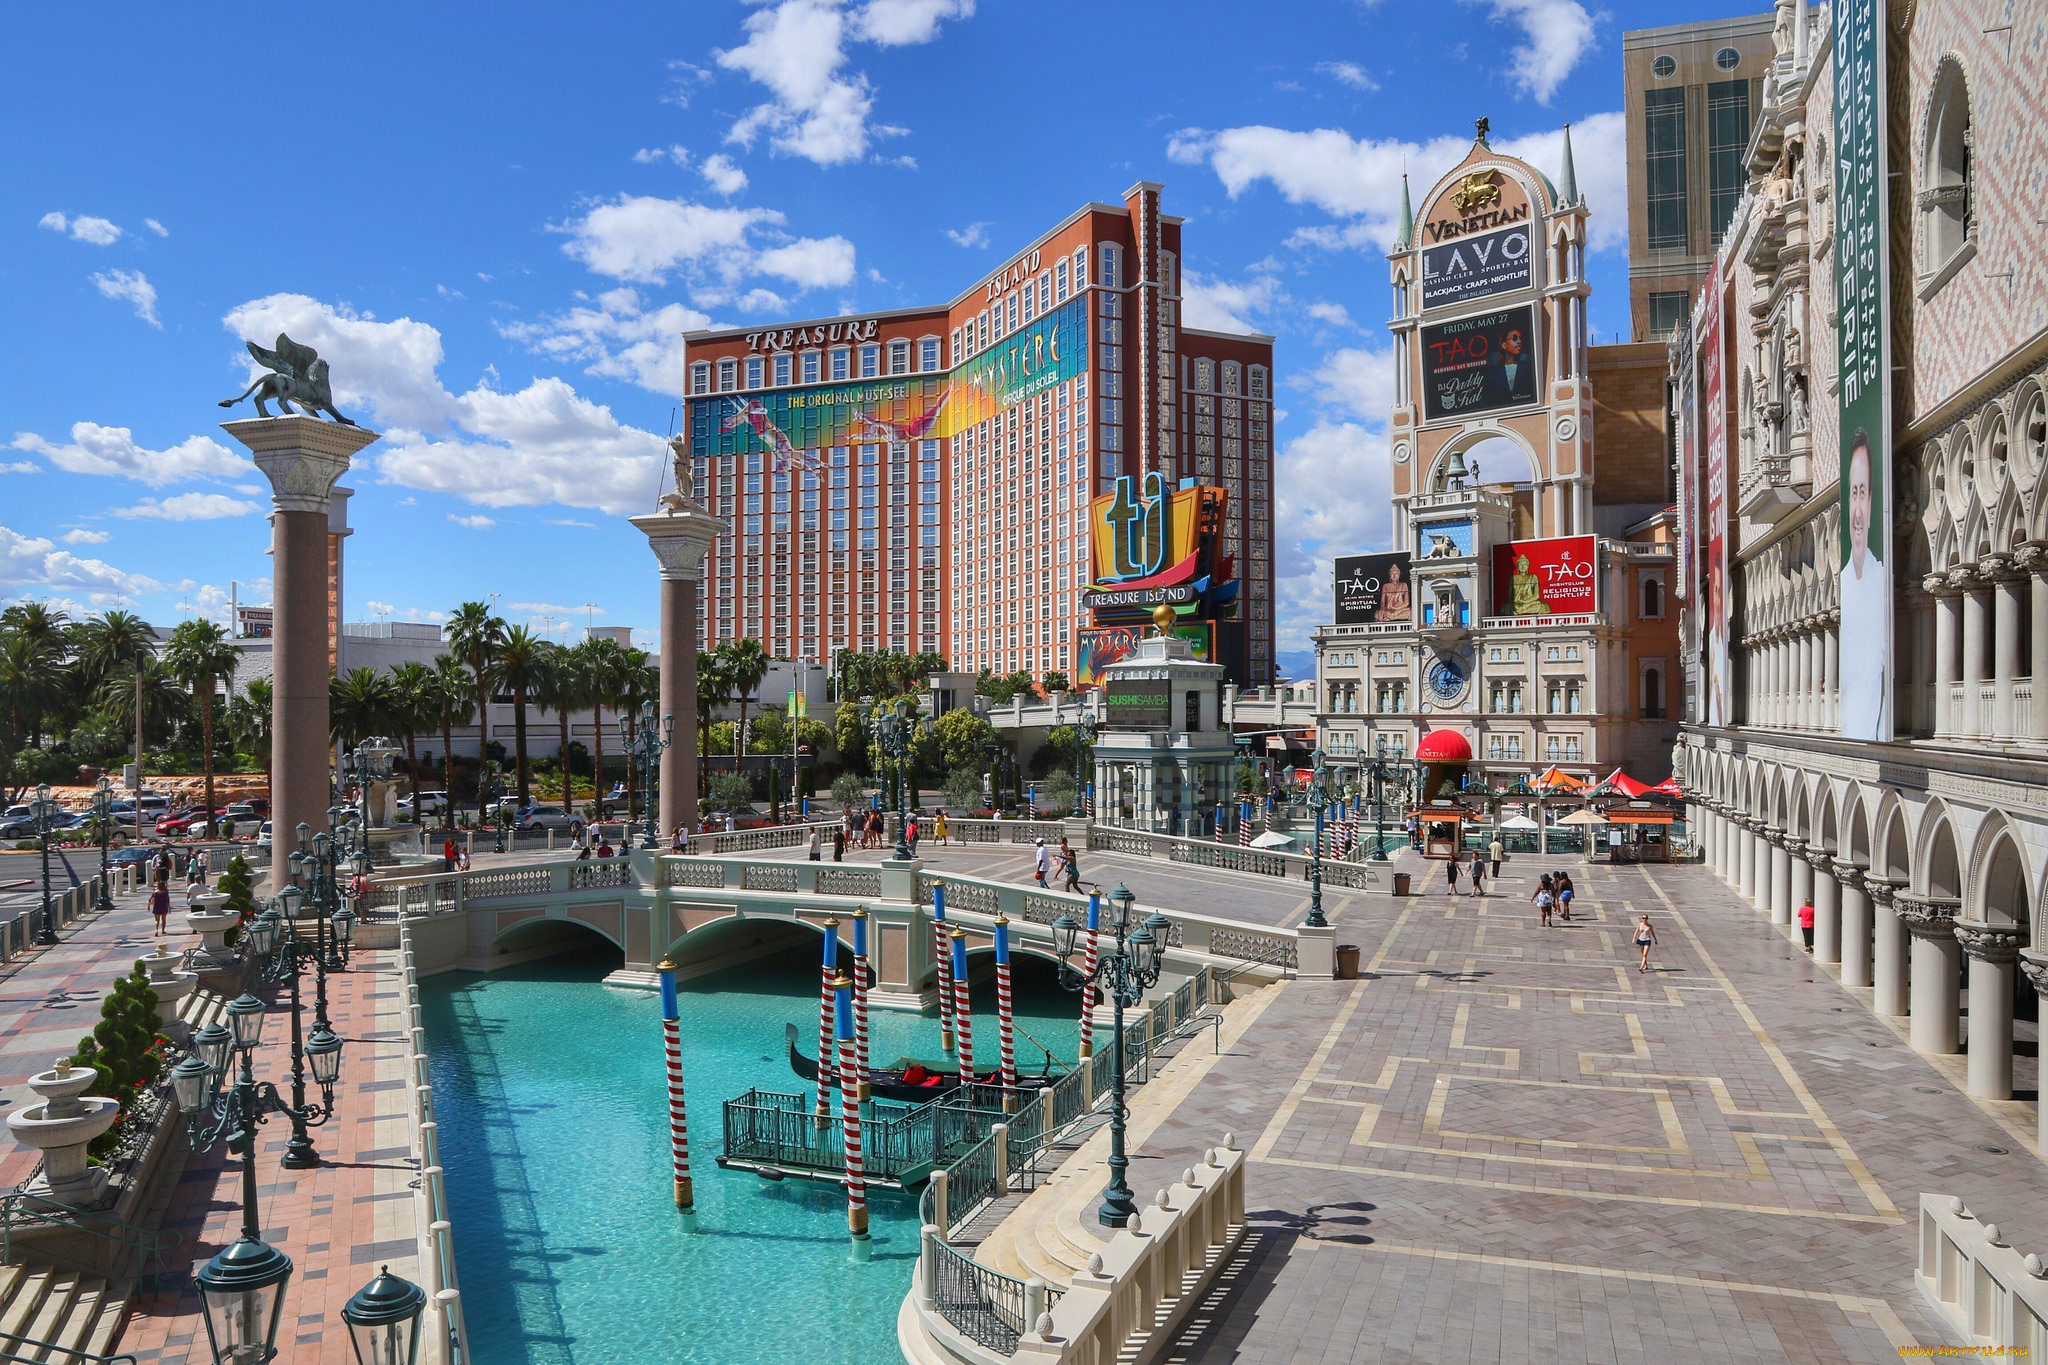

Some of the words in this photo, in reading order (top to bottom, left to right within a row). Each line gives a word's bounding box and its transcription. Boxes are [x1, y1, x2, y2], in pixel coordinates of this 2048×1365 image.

[1864, 60, 1873, 207] DANIEL
[1858, 139, 1865, 185] TO
[1425, 203, 1528, 243] VENETIAN
[1424, 233, 1528, 279] LAVO
[986, 250, 1041, 303] ISLAND
[1424, 276, 1451, 287] CASINO
[1453, 270, 1473, 280] CLUB
[1480, 261, 1511, 274] SPORTS
[1514, 257, 1529, 266] BAR
[1425, 284, 1463, 299] BLACKJACK
[1465, 278, 1488, 289] CRAPS
[1490, 269, 1529, 284] NIGHTLIFE
[1469, 288, 1493, 298] PALAZZO
[1867, 221, 1877, 380] BOULUD
[745, 319, 878, 351] TREASURE
[1477, 315, 1497, 328] MAY
[1498, 313, 1508, 323] 27
[1861, 286, 1870, 386] STRIP
[1429, 334, 1489, 364] TAO
[1433, 365, 1456, 374] MEMORIAL
[1467, 360, 1487, 368] WEEKEND
[787, 396, 806, 409] THE
[808, 391, 855, 407] ORIGINAL
[857, 386, 906, 402] MUST-SEE
[1002, 386, 1025, 406] CIRQUE
[1026, 381, 1035, 395] DU
[1035, 370, 1059, 390] SOLEIL
[1708, 390, 1721, 436] THE
[1708, 433, 1721, 470] CAKE
[1709, 466, 1722, 505] BOSS
[1709, 509, 1716, 542] IS
[1715, 502, 1722, 538] IN
[1337, 577, 1380, 595] TAO
[1540, 561, 1593, 582] TAO
[1089, 592, 1140, 607] TREASURE
[1543, 586, 1592, 594] RELIGIOUS
[1543, 591, 1590, 599] NIGHTLIFE
[1108, 694, 1168, 706] SUSHISAMBA
